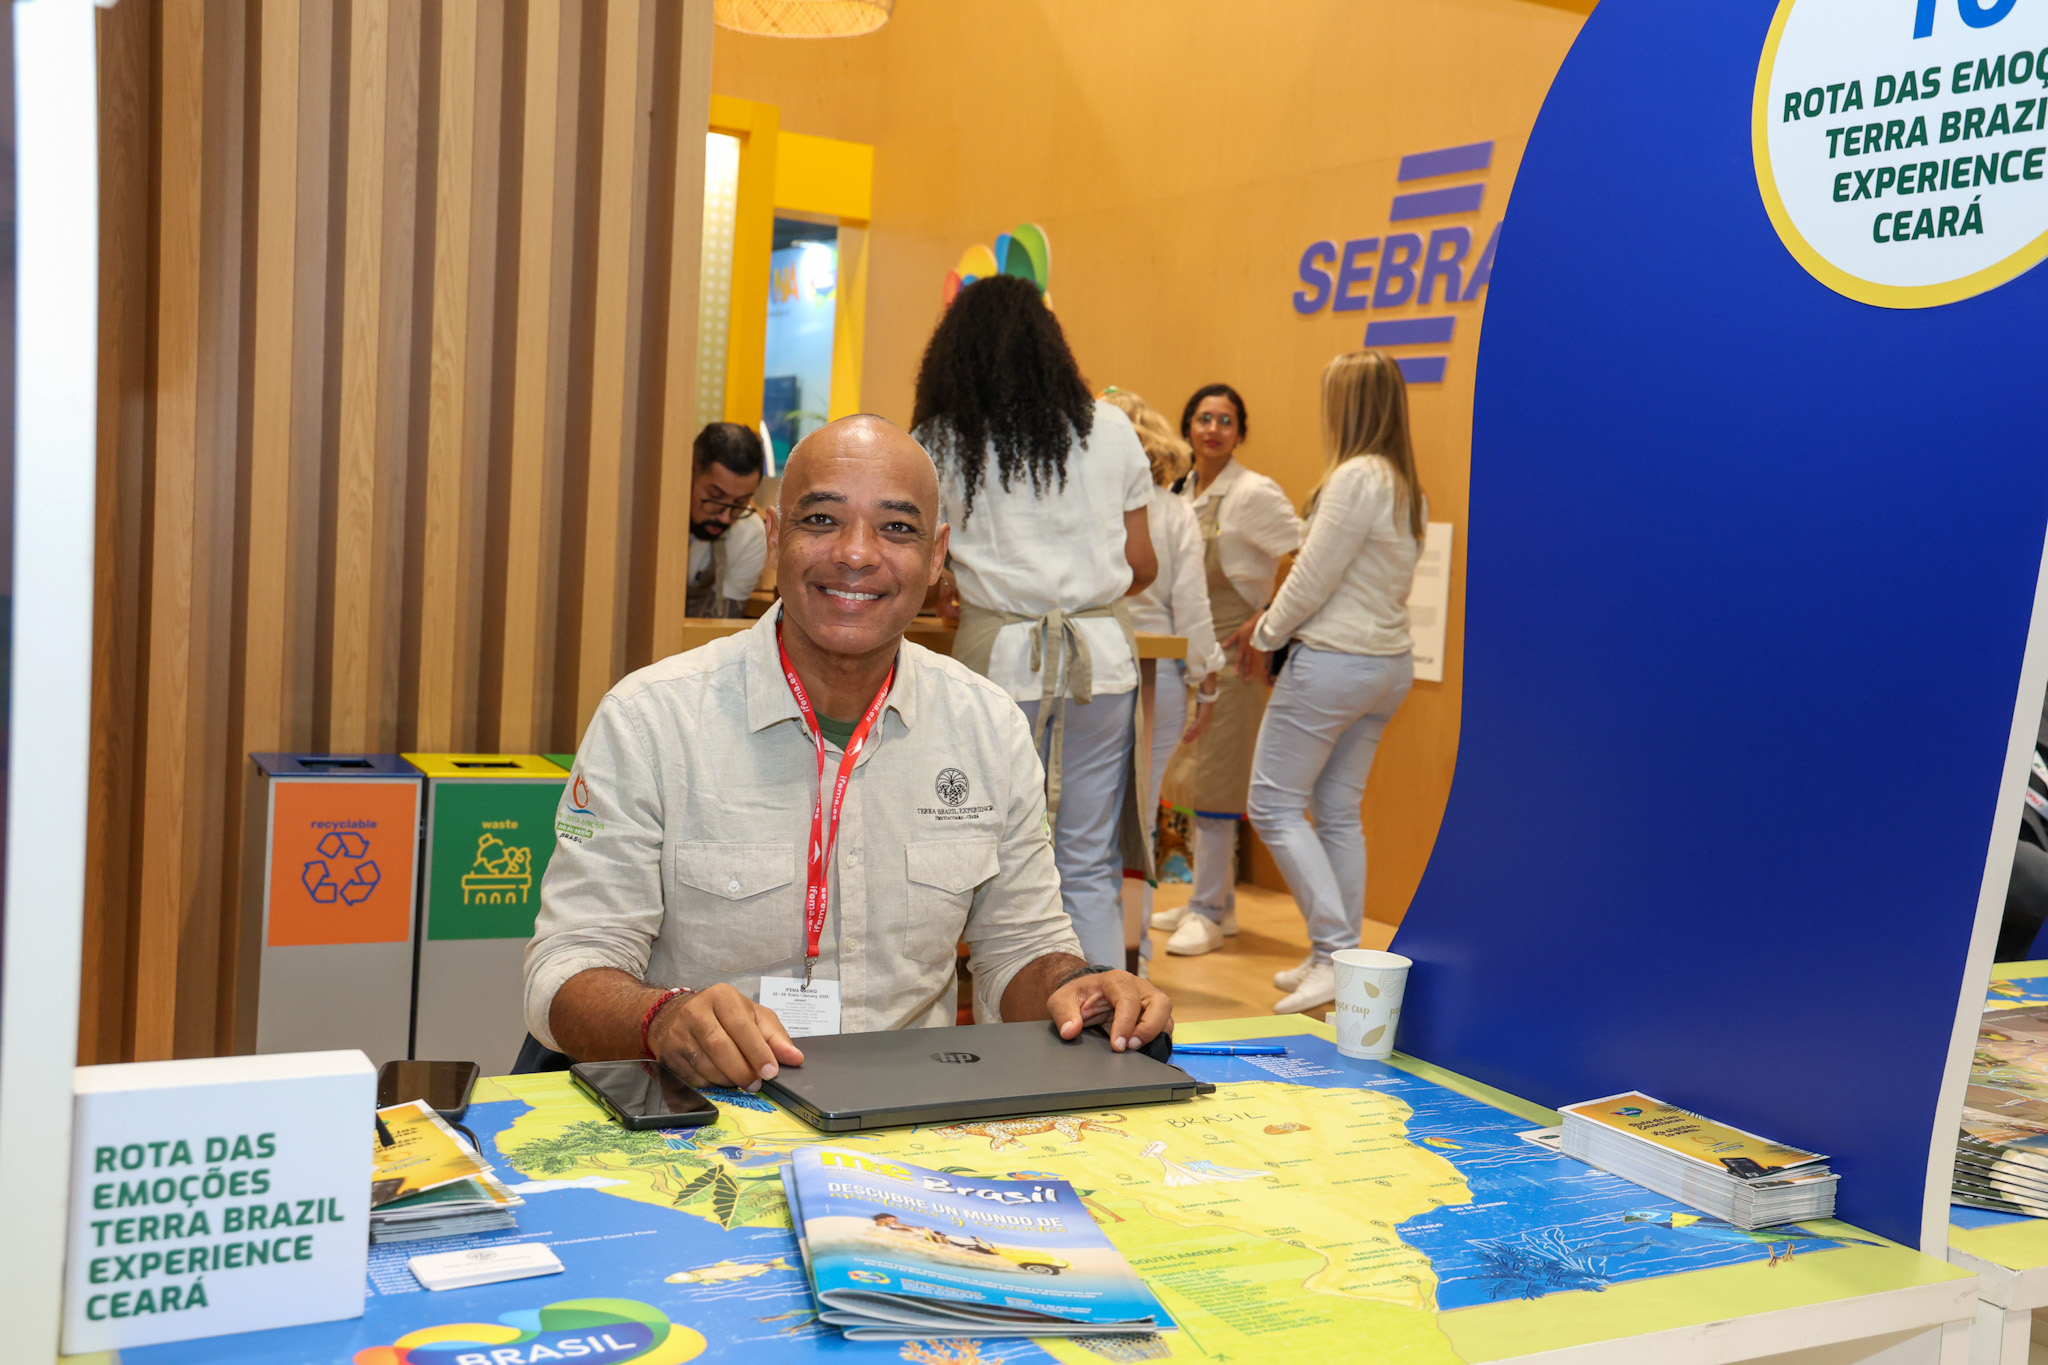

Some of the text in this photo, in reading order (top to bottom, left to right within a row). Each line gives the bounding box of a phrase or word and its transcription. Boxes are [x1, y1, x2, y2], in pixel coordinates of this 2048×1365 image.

[1783, 80, 1864, 123] ROTA
[1873, 66, 1942, 108] DAS
[1825, 115, 1929, 159] TERRA
[1832, 146, 2047, 203] EXPERIENCE
[1872, 194, 1984, 244] CEARÁ
[787, 672, 810, 713] ifema.es
[865, 686, 889, 722] ifema.es
[832, 775, 848, 821] ifema.es
[960, 805, 994, 814] EXPERIENCE
[310, 819, 378, 831] recyclable
[482, 820, 519, 830] waste
[813, 887, 827, 933] ifema.es
[1351, 1004, 1370, 1020] cup
[1165, 1111, 1266, 1129] BRASIL
[95, 1132, 276, 1173] ROTA DAS
[93, 1166, 271, 1210] EMOÇÕES
[827, 1182, 1065, 1228] DESCUBRE UN MUNDO DE
[921, 1175, 1059, 1206] Brasil
[91, 1197, 345, 1247] TERRA BRAZIL
[495, 1231, 553, 1241] International
[88, 1235, 314, 1285] EXPERIENCE
[1128, 1246, 1238, 1267] SOUTH AMERICA
[86, 1276, 209, 1321] CEARÁ
[455, 1334, 637, 1365] BRASIL
